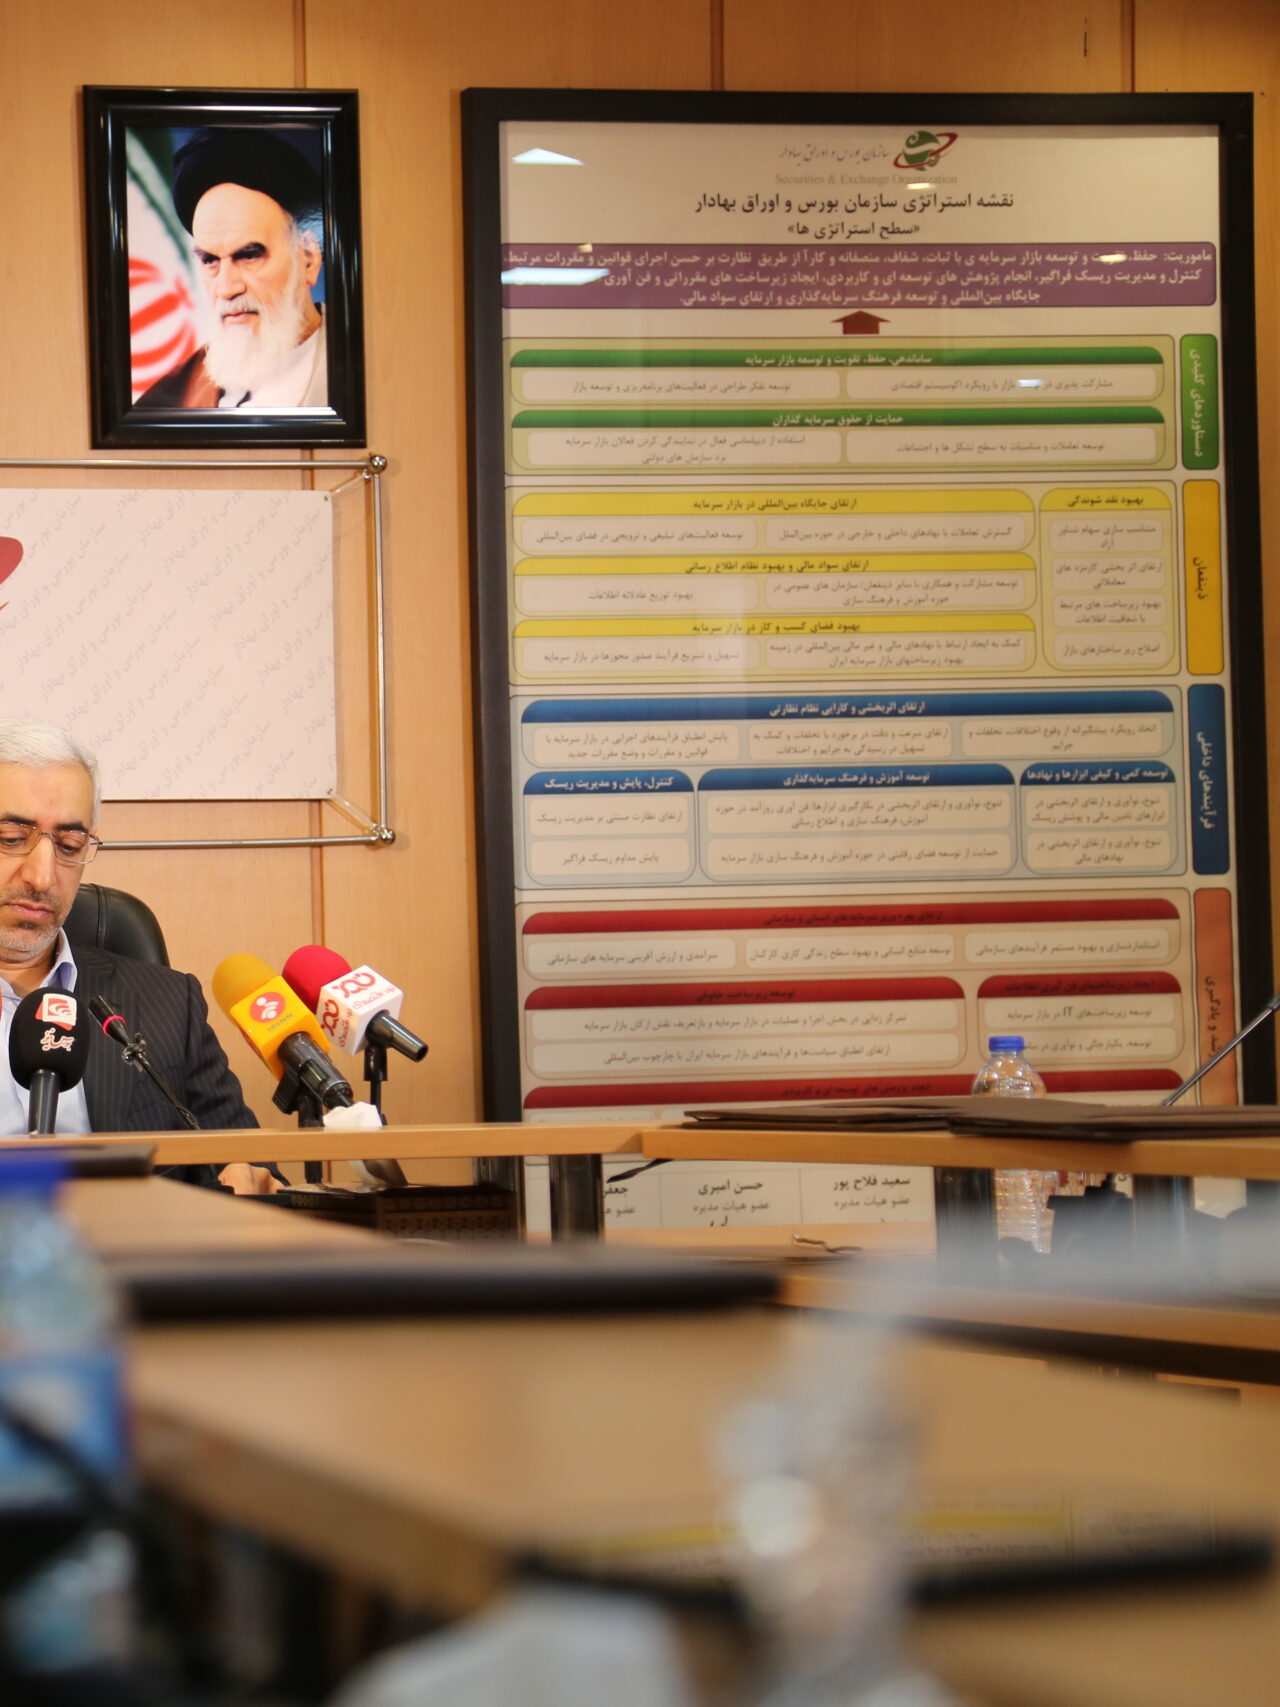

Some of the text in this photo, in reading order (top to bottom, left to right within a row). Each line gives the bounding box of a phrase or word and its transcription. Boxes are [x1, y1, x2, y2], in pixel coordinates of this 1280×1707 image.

[776, 174, 824, 184] Securities
[841, 174, 889, 186] Exchange
[696, 193, 1014, 213] نقشه استراتژی سازمان بورس و اوراق بهادار
[815, 222, 875, 239] استراتژی
